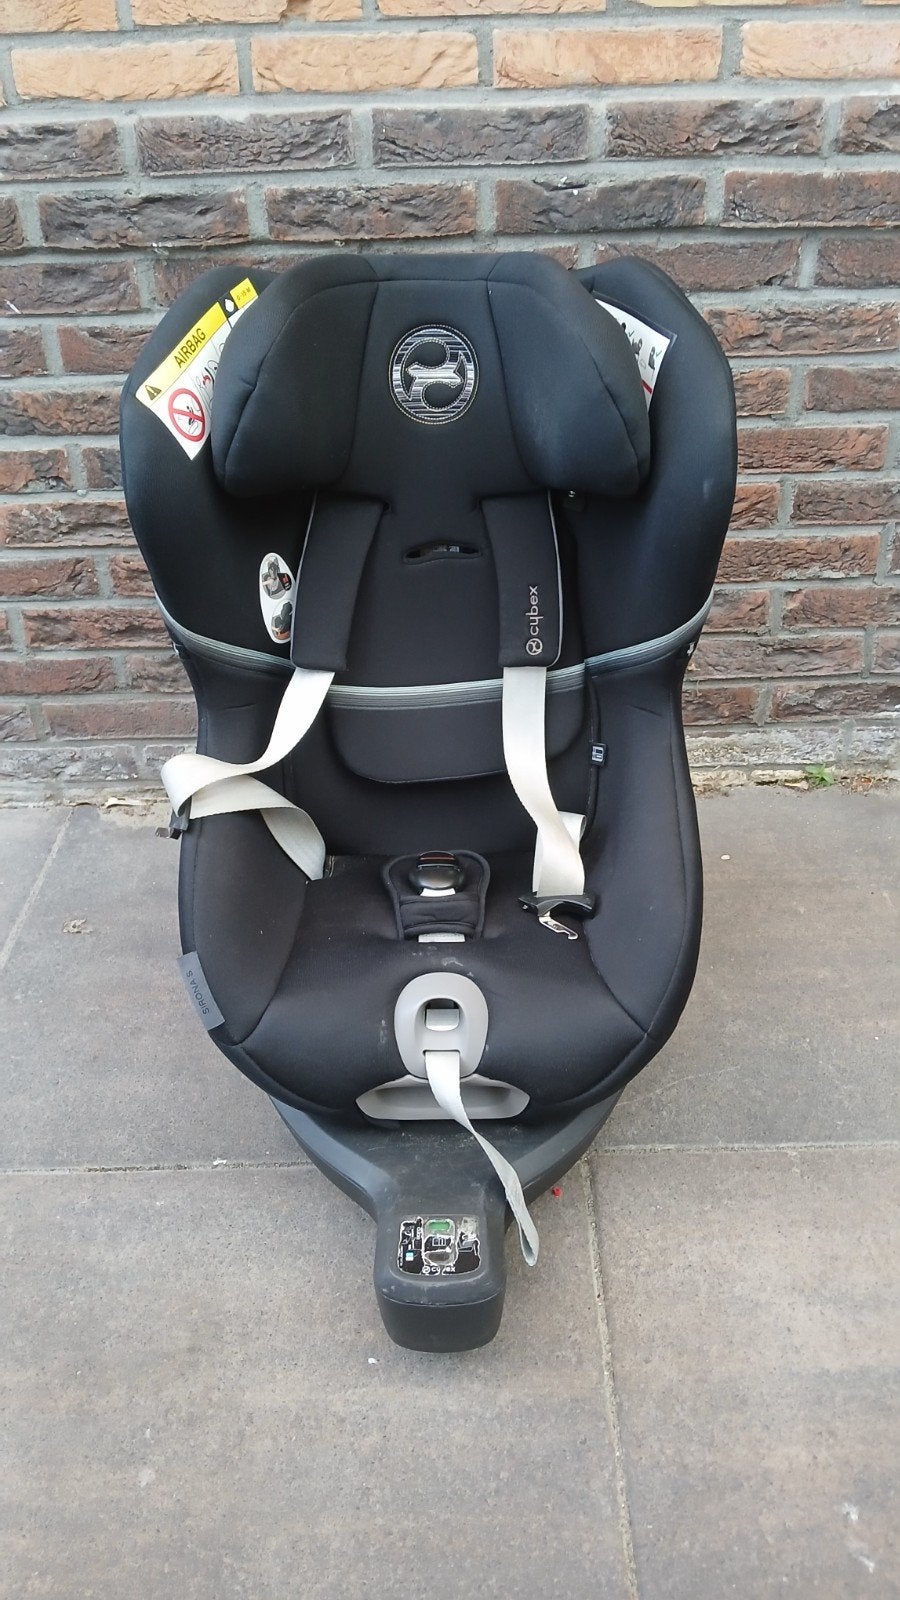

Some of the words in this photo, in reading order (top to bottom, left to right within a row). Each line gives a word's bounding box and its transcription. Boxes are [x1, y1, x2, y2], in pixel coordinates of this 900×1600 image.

[174, 328, 206, 368] AIRBAG
[525, 585, 544, 636] cybex
[186, 970, 194, 978] S
[190, 979, 210, 1015] SIRONA
